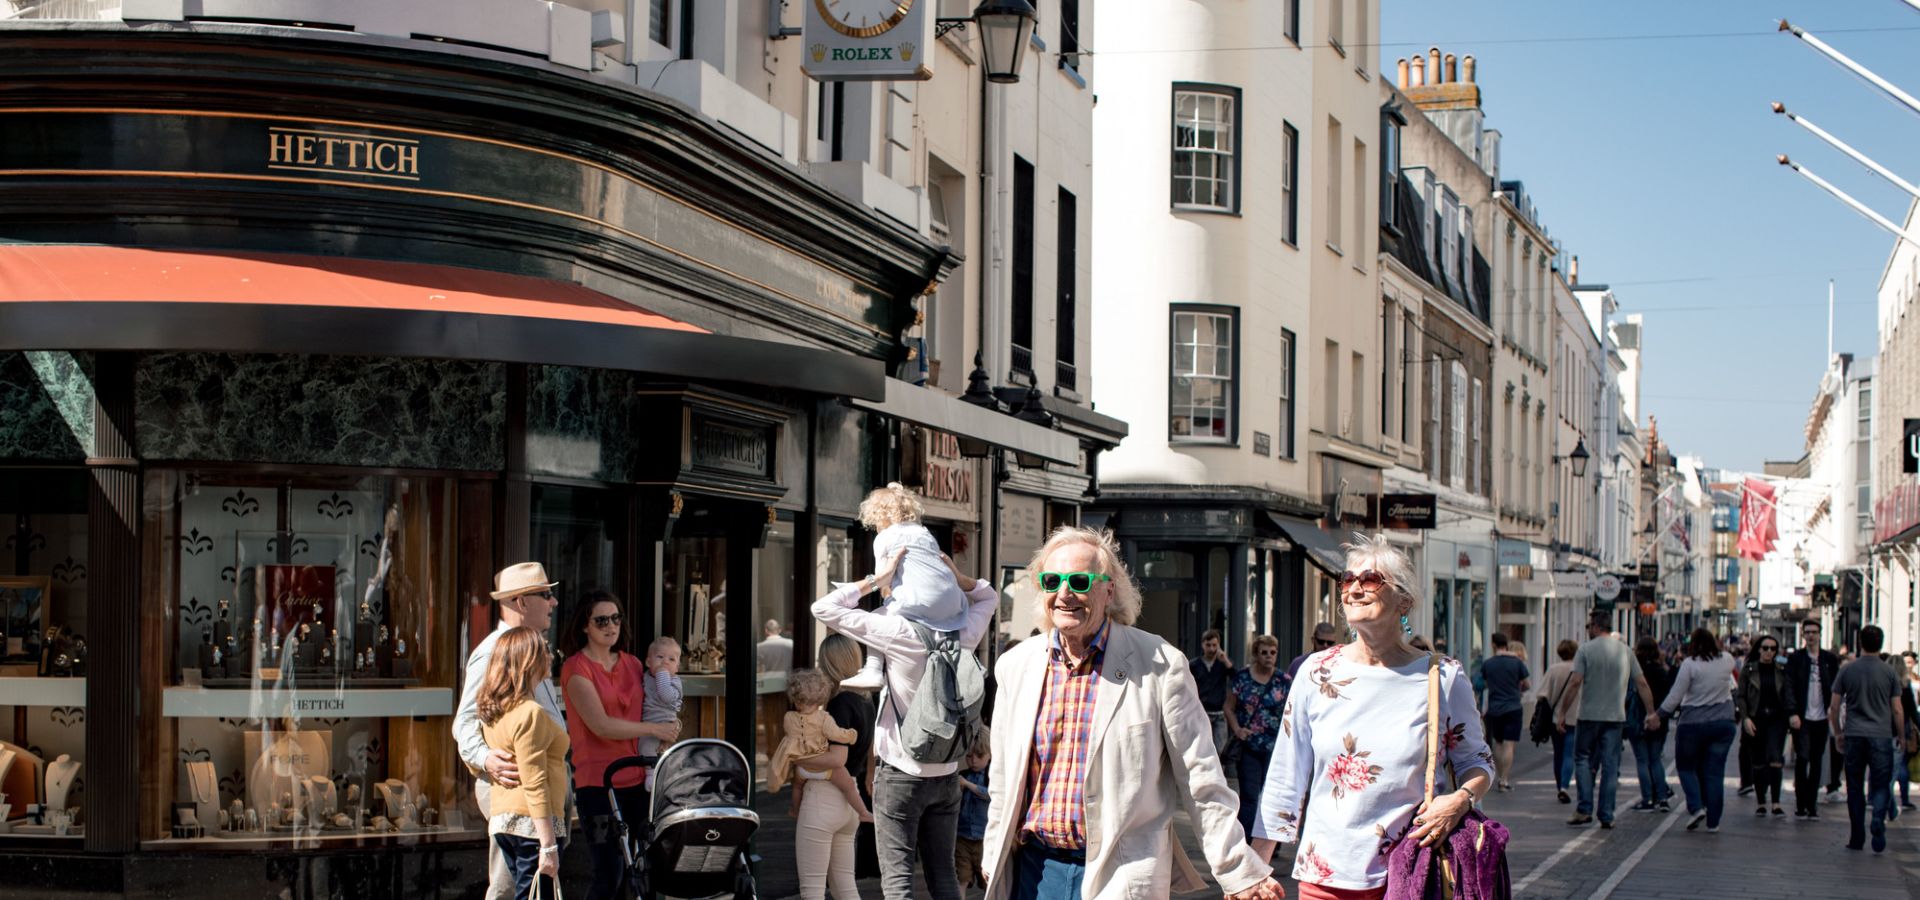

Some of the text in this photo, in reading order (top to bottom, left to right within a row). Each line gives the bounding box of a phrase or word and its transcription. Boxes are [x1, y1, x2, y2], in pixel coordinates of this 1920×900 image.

[832, 47, 892, 61] ROLEX
[269, 133, 418, 175] HETTICH
[920, 464, 970, 503] EIRSON
[293, 699, 344, 710] HETTICH
